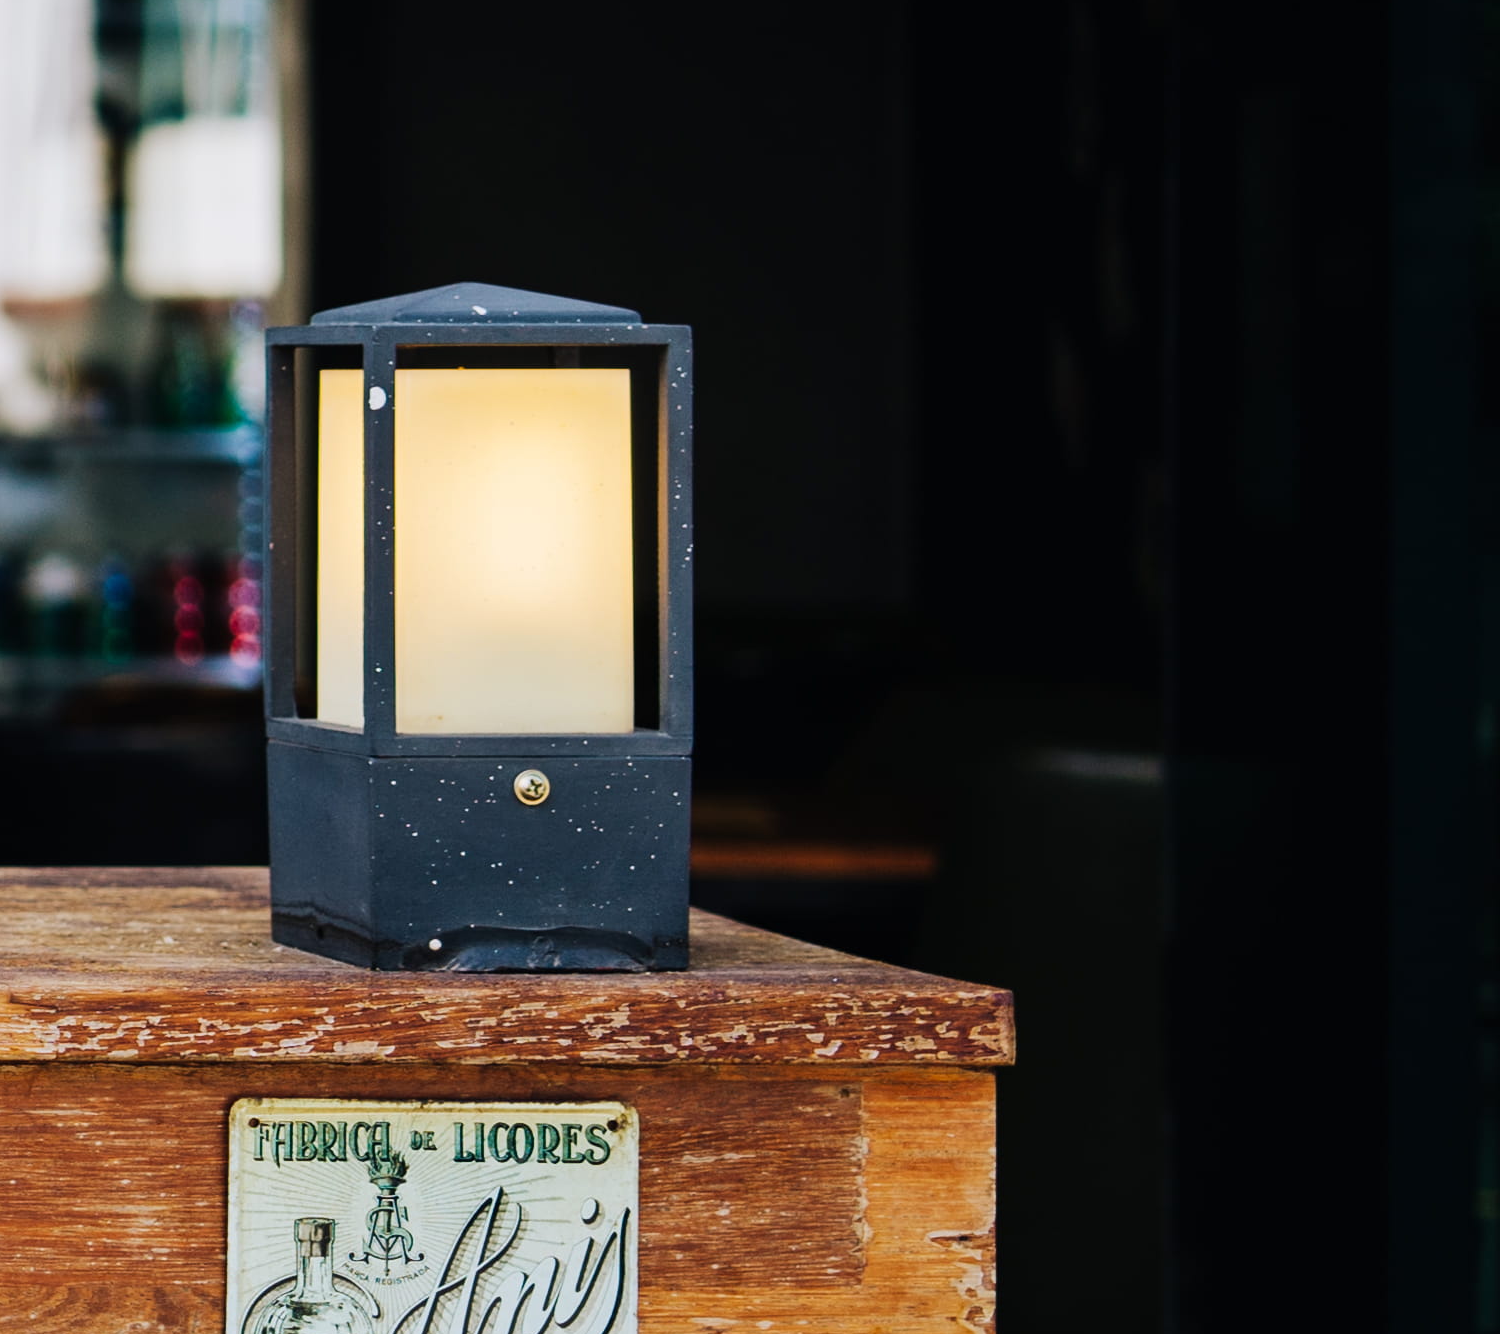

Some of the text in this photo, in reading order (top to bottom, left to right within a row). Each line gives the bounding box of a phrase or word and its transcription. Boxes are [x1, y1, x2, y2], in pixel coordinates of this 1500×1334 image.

[253, 1121, 612, 1168] FABRICA DE LICORES
